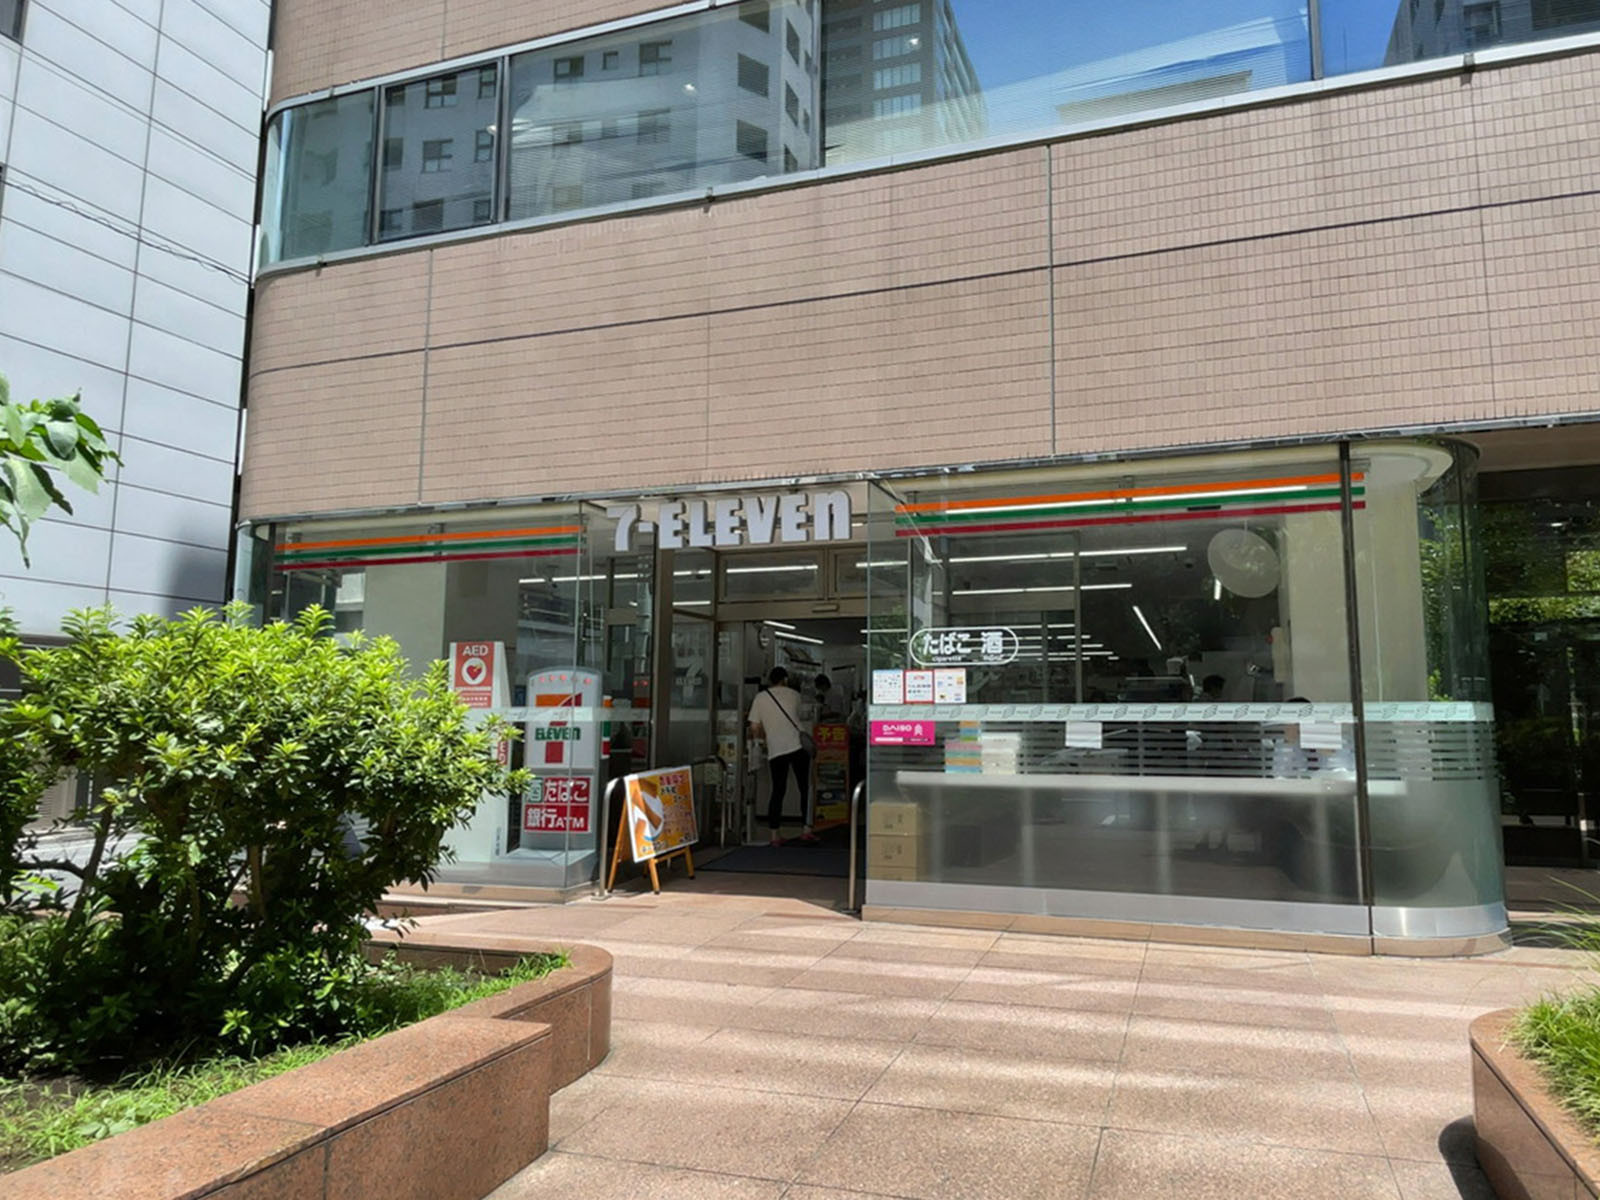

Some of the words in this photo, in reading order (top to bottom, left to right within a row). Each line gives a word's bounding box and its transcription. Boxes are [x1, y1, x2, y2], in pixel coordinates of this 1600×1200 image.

[462, 645, 489, 657] AED
[923, 631, 972, 656] たばこ
[980, 631, 1004, 654] 酒
[544, 779, 588, 803] たばこ
